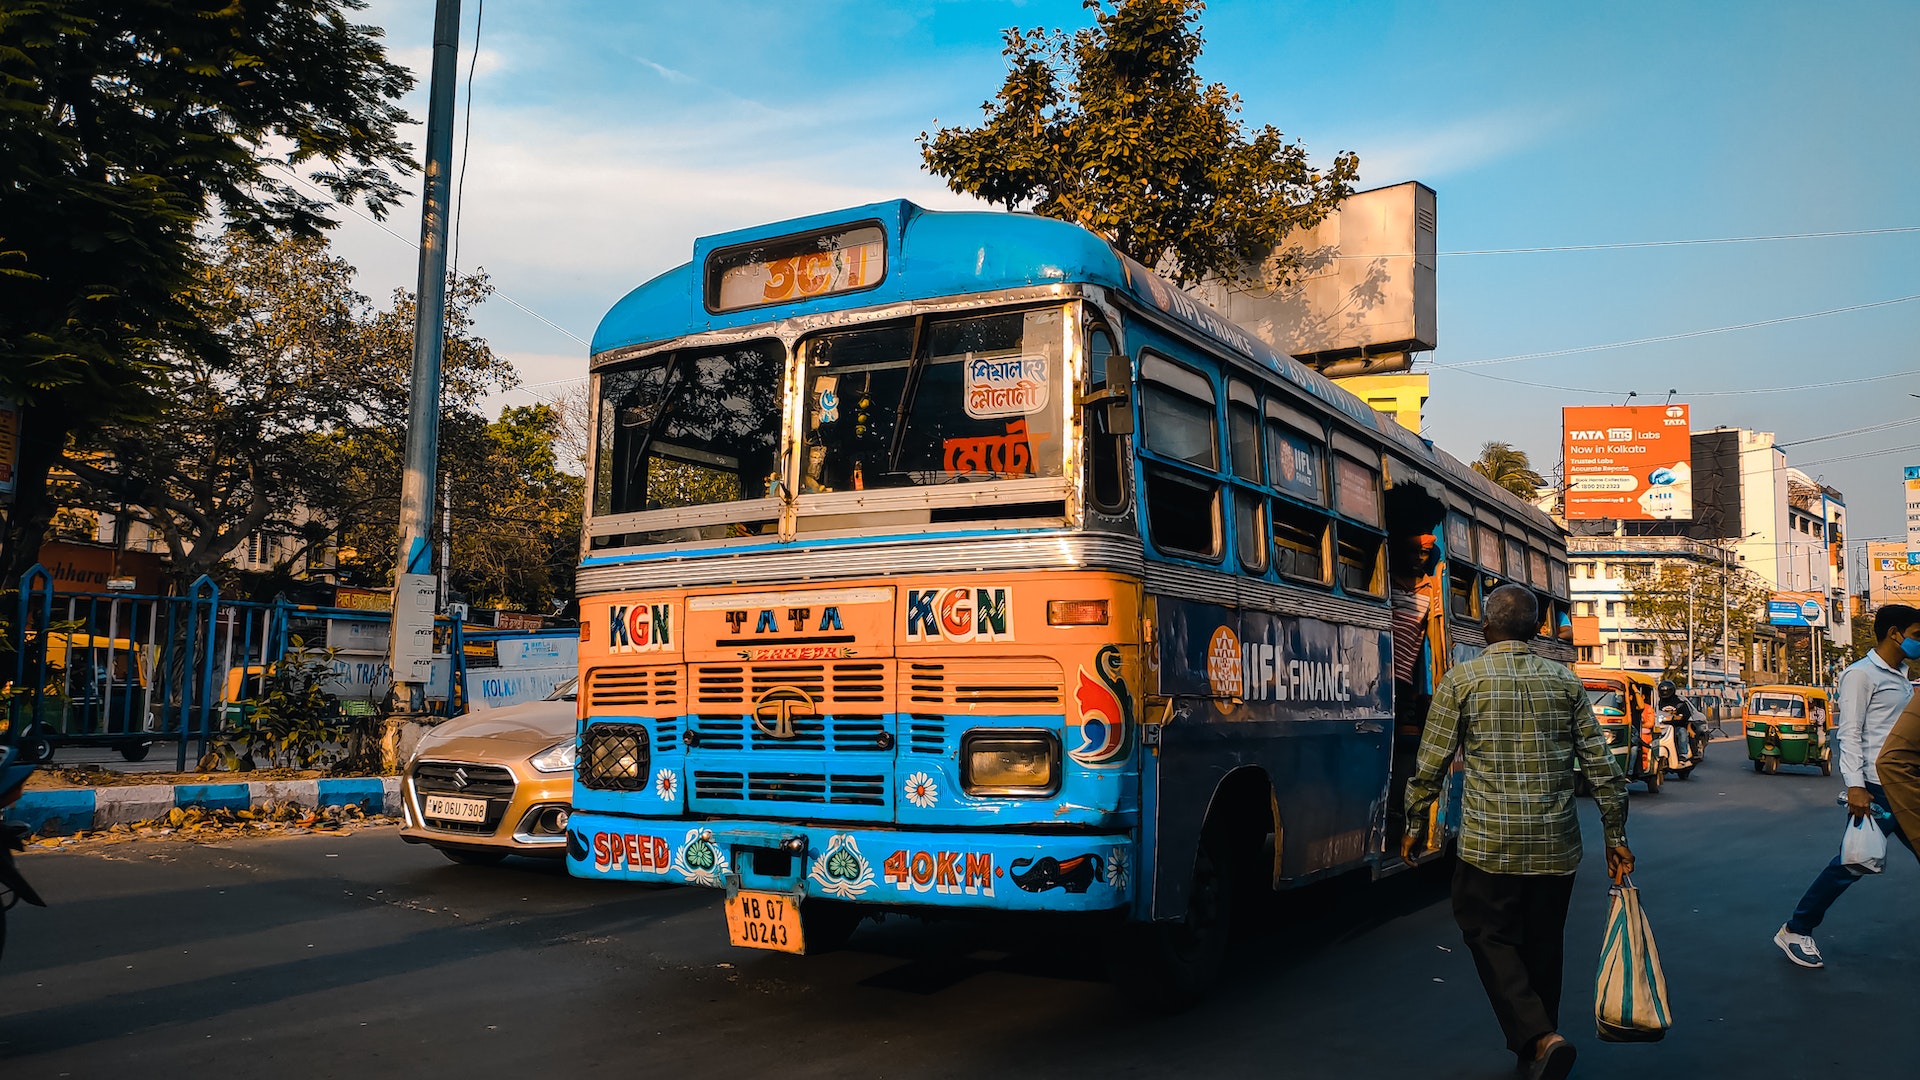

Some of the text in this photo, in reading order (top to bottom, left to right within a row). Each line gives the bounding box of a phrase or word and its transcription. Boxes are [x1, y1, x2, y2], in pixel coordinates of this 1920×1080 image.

[1167, 287, 1254, 358] IIFL FINANCE
[970, 359, 1047, 382] শিয়ালদহ
[1569, 427, 1661, 442] TATA 1mg Labs
[1662, 418, 1687, 426] TATA
[1294, 447, 1312, 476] IIFL
[1570, 444, 1647, 454] Now in Kolkata
[1602, 465, 1630, 473] Reports
[609, 602, 675, 653] KGN
[725, 606, 845, 635] TATA
[905, 586, 1016, 643] KGN
[1242, 642, 1351, 702] IIFL FINANCE
[431, 799, 443, 814] WB
[462, 803, 485, 818] 7908
[593, 831, 671, 875] SPEED
[741, 896, 784, 921] WB 07
